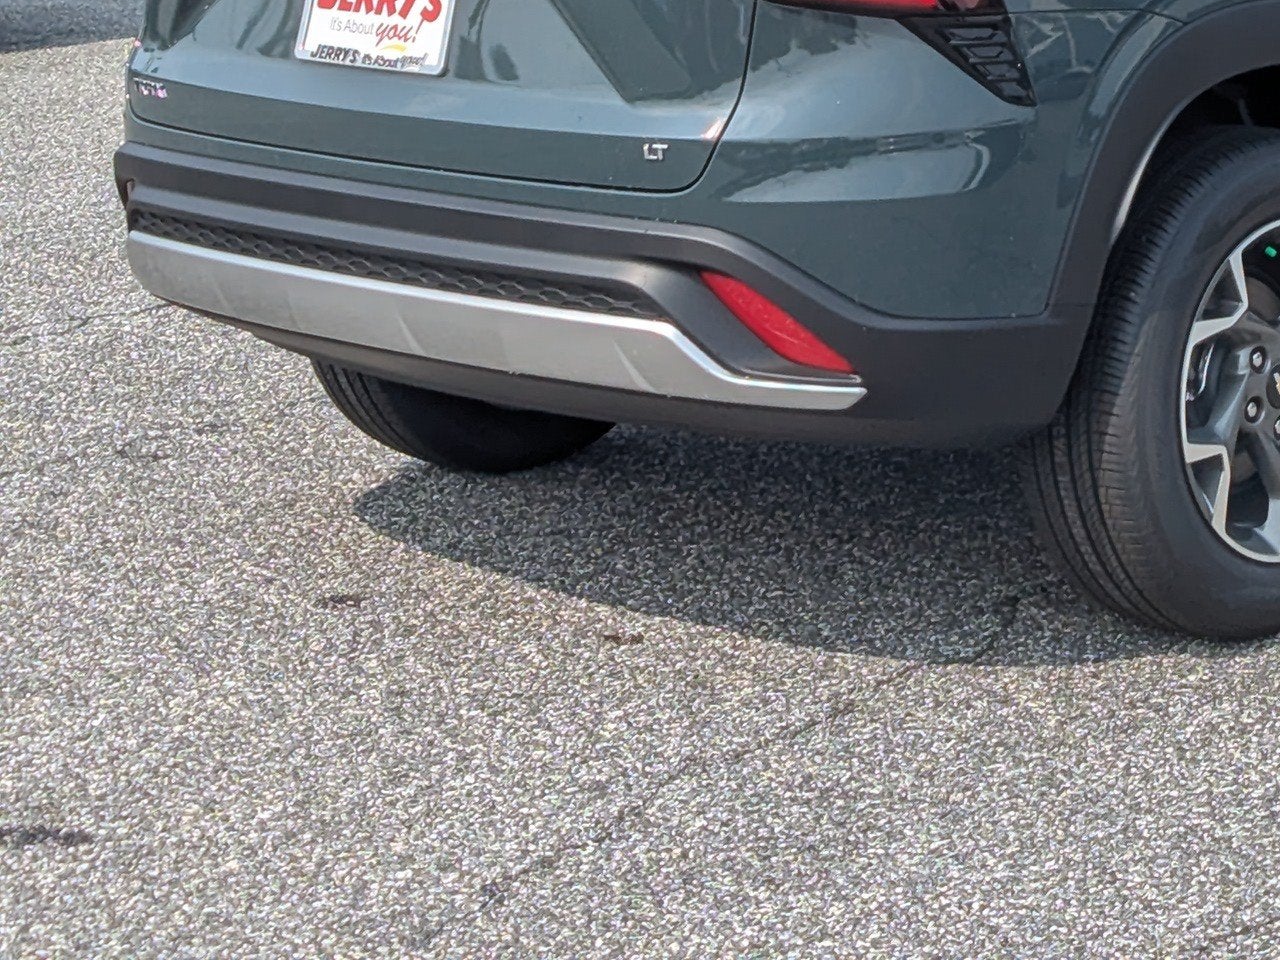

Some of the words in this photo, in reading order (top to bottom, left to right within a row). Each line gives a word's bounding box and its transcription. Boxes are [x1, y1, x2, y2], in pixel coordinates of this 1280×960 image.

[344, 19, 374, 35] About
[375, 19, 424, 47] you!
[310, 44, 361, 64] JERRY'S
[643, 143, 669, 160] LT
